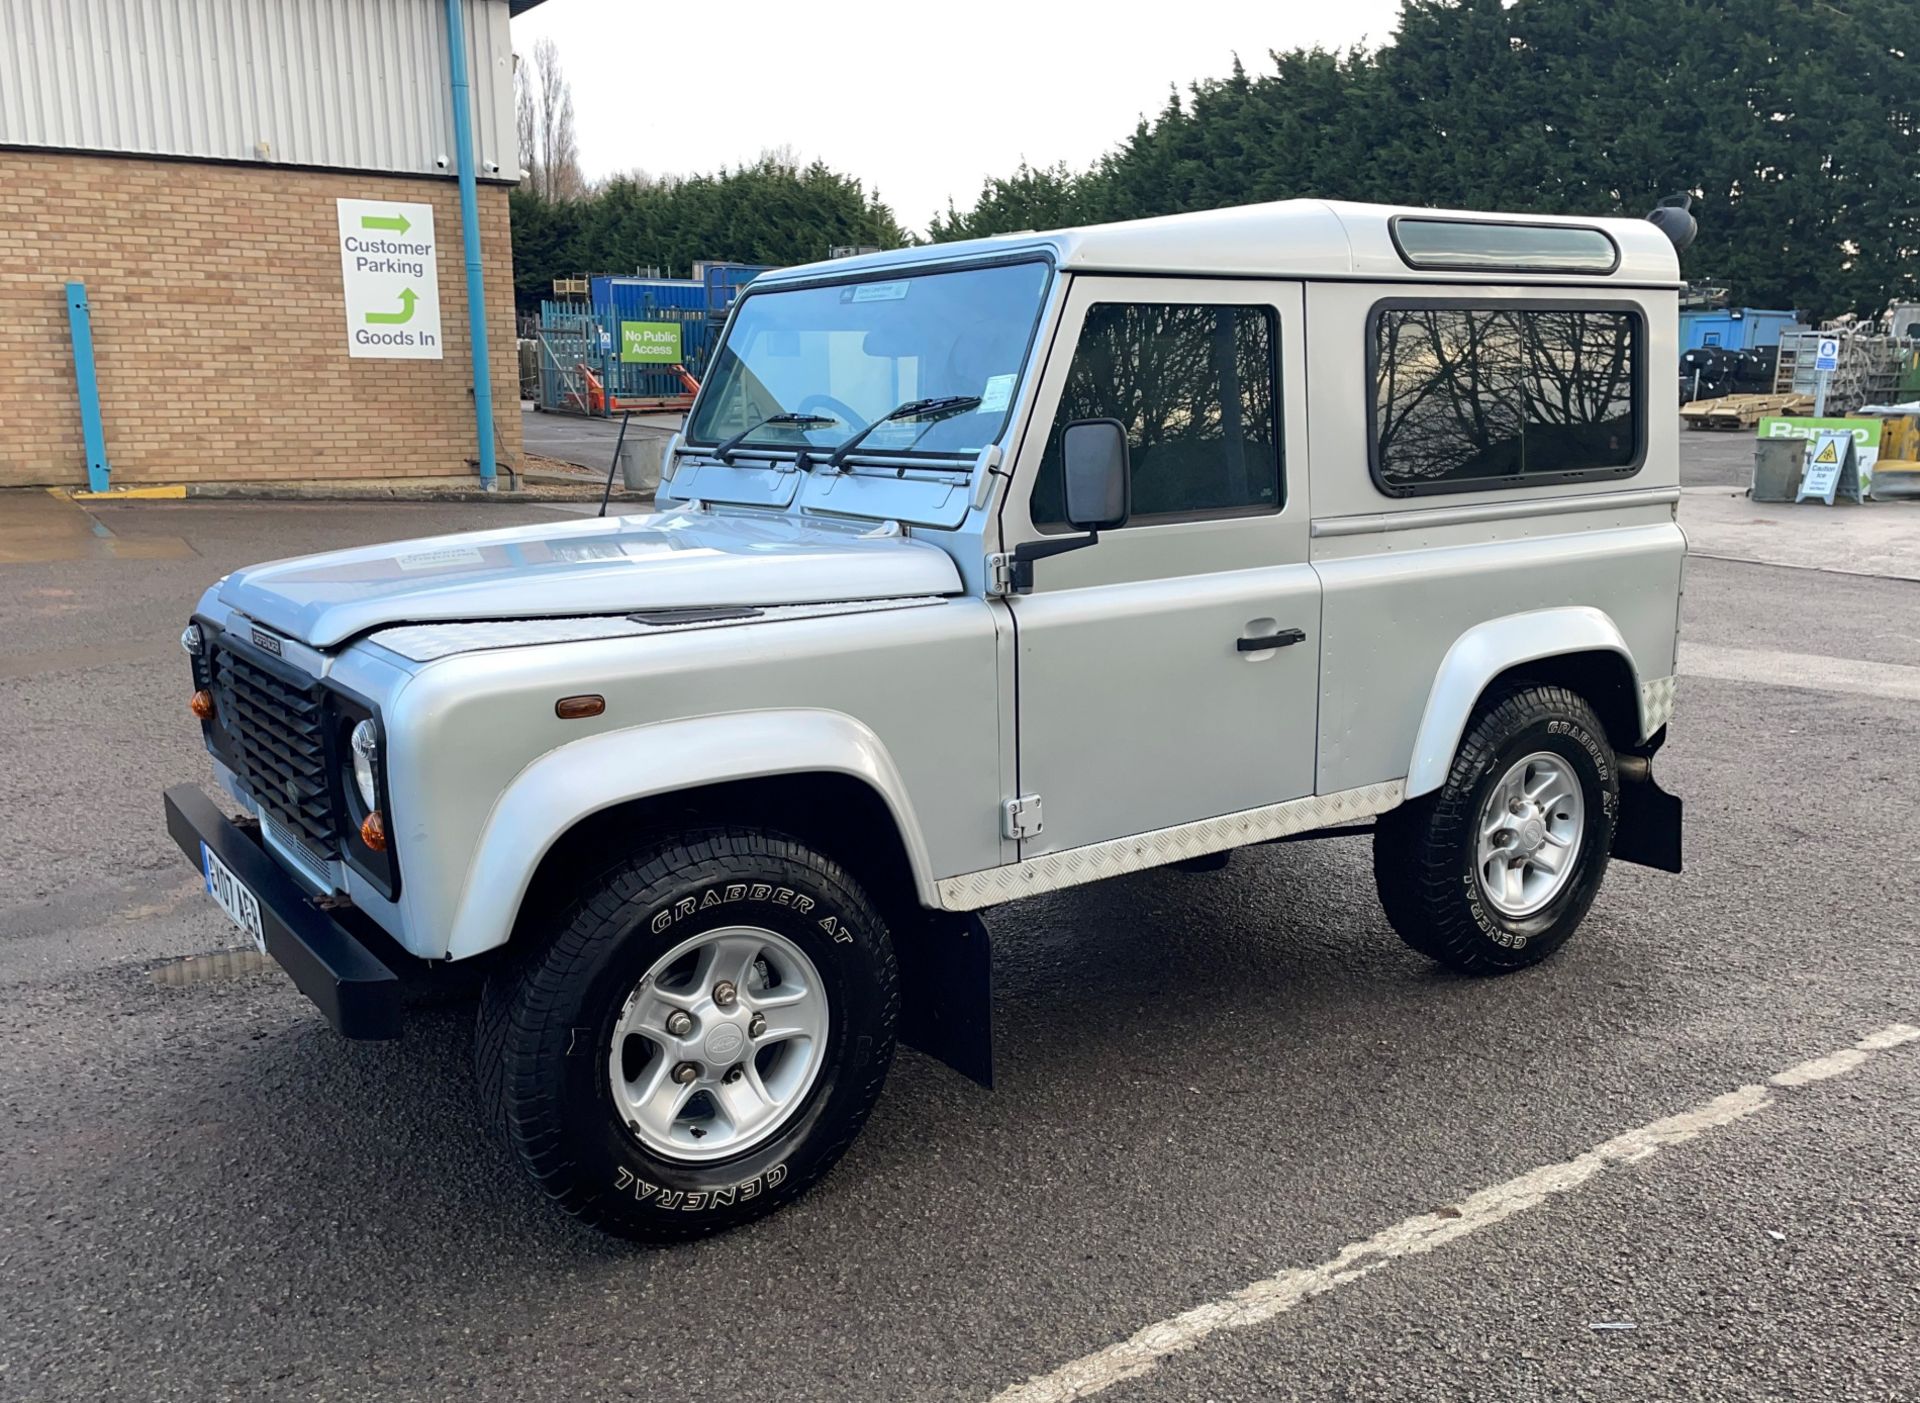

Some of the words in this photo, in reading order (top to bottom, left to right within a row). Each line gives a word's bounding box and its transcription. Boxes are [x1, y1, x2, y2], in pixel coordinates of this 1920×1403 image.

[345, 236, 432, 256] Customer
[356, 257, 424, 278] Parking
[355, 329, 414, 346] Goods
[419, 331, 435, 346] In
[625, 330, 641, 342] No
[643, 331, 678, 343] Public
[632, 343, 672, 355] Access
[1812, 464, 1836, 473] Caution
[1547, 720, 1609, 781] GRABBER
[651, 883, 815, 934] GRABBER
[818, 916, 854, 944] AT
[1463, 867, 1527, 949] GENERAL
[614, 1163, 788, 1211] GENERAL
